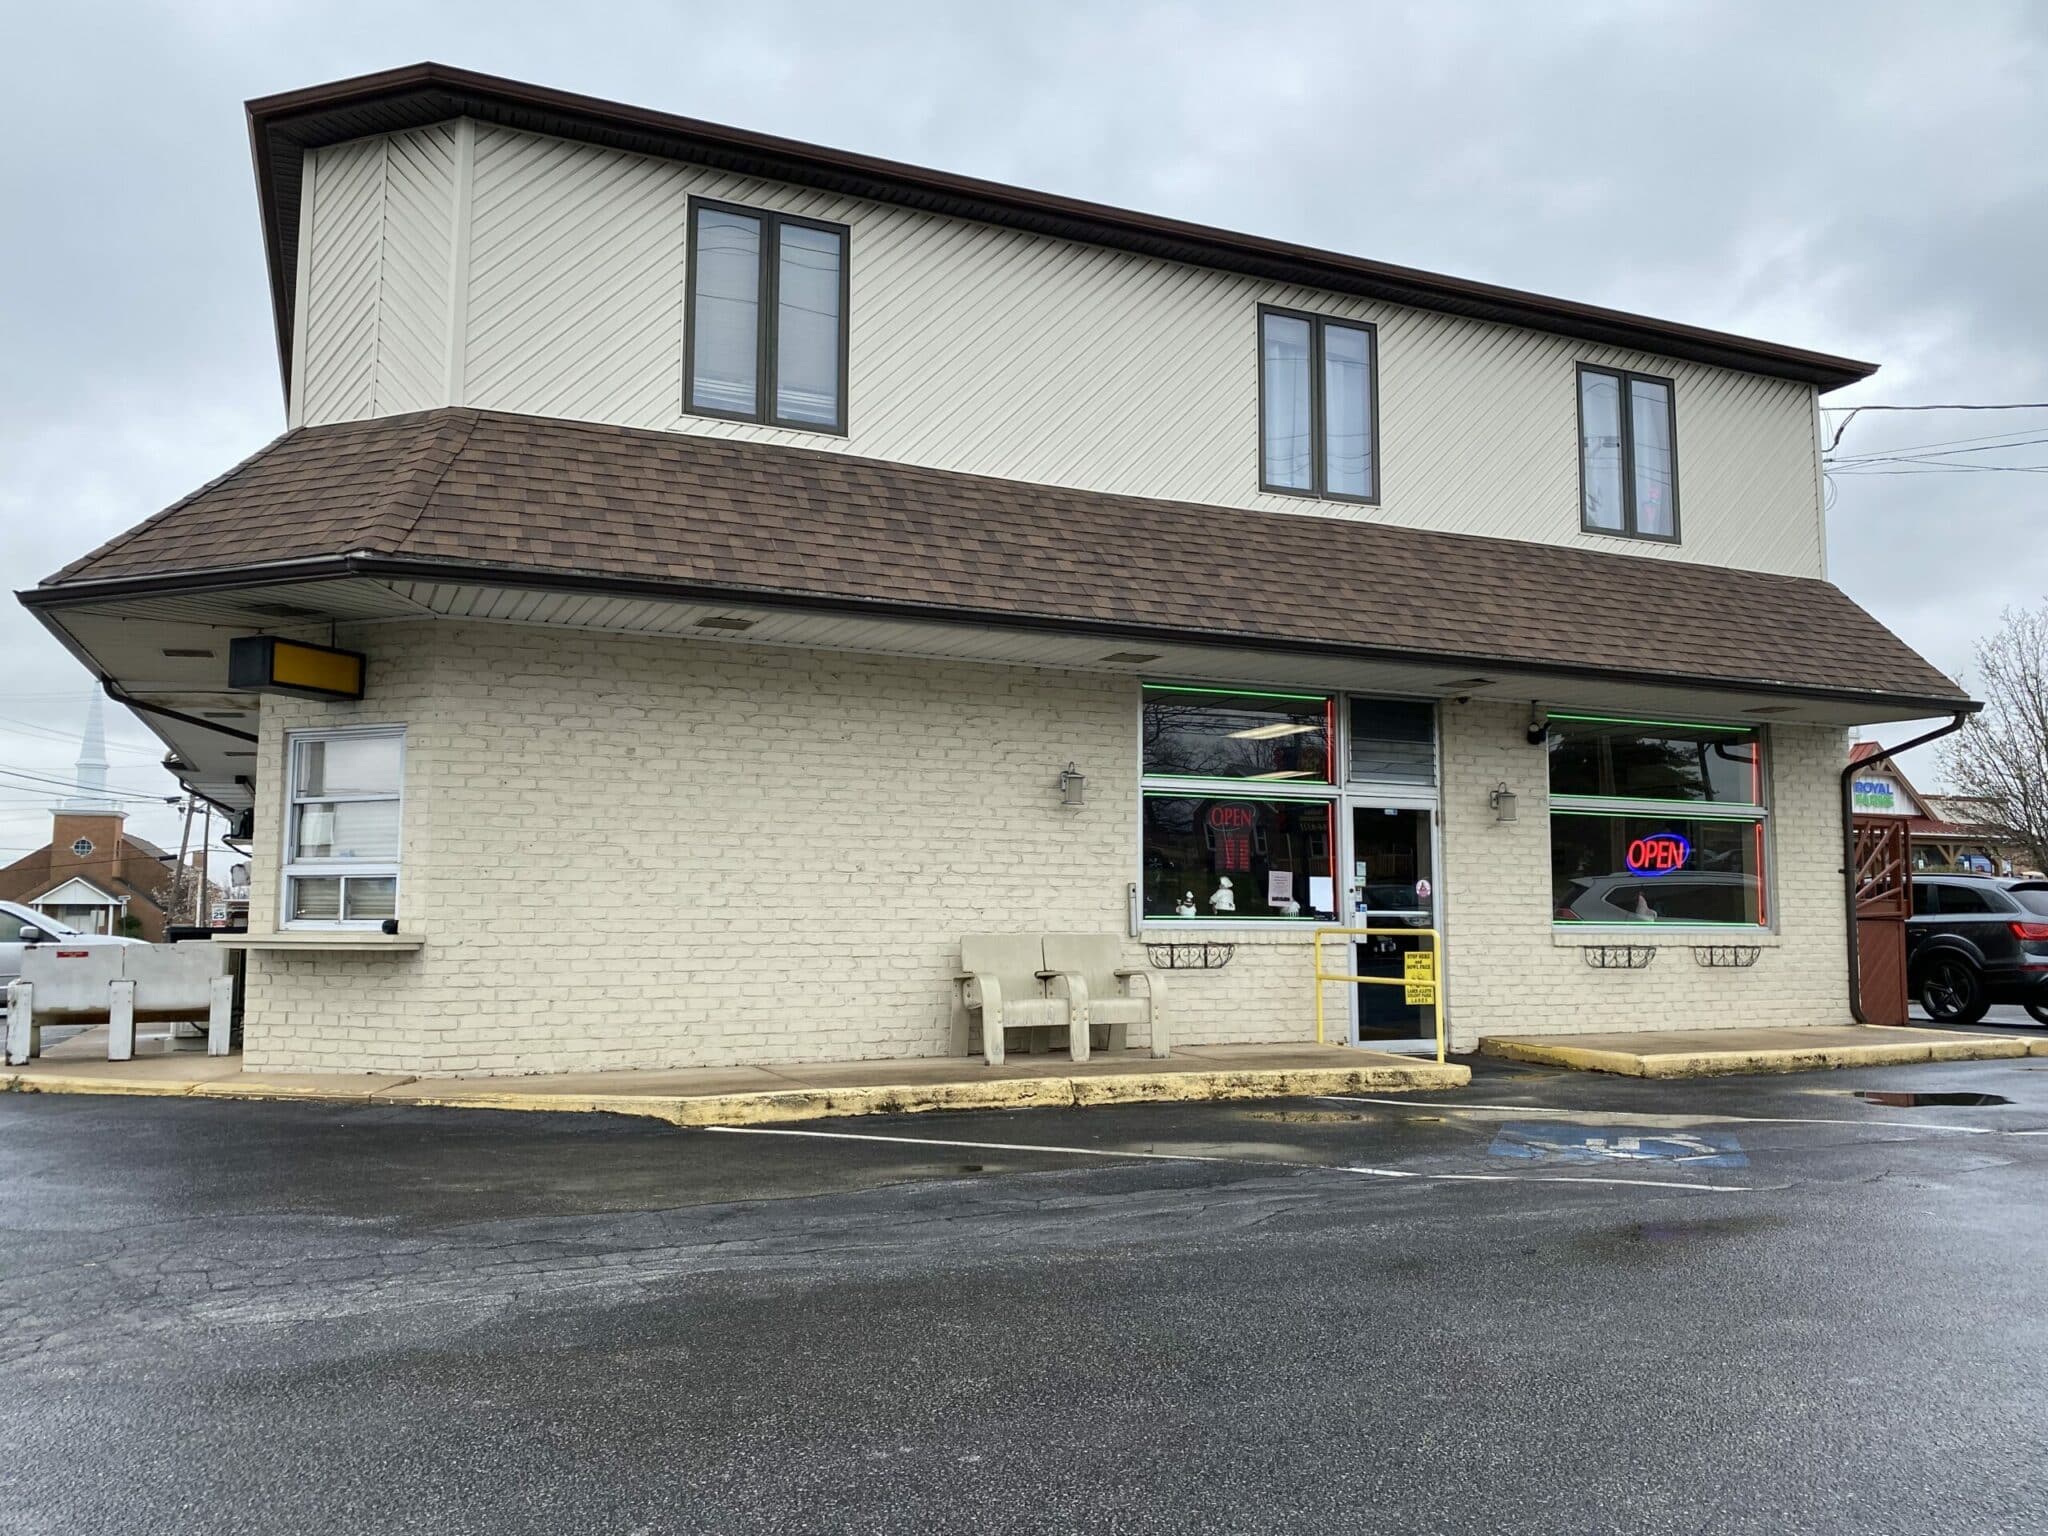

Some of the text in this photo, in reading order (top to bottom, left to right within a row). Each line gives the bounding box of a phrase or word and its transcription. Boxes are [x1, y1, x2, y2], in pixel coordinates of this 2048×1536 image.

[1854, 782, 1893, 795] ROYAL
[1211, 807, 1251, 828] OPEN
[1628, 840, 1684, 869] OPEN
[213, 911, 225, 920] 25
